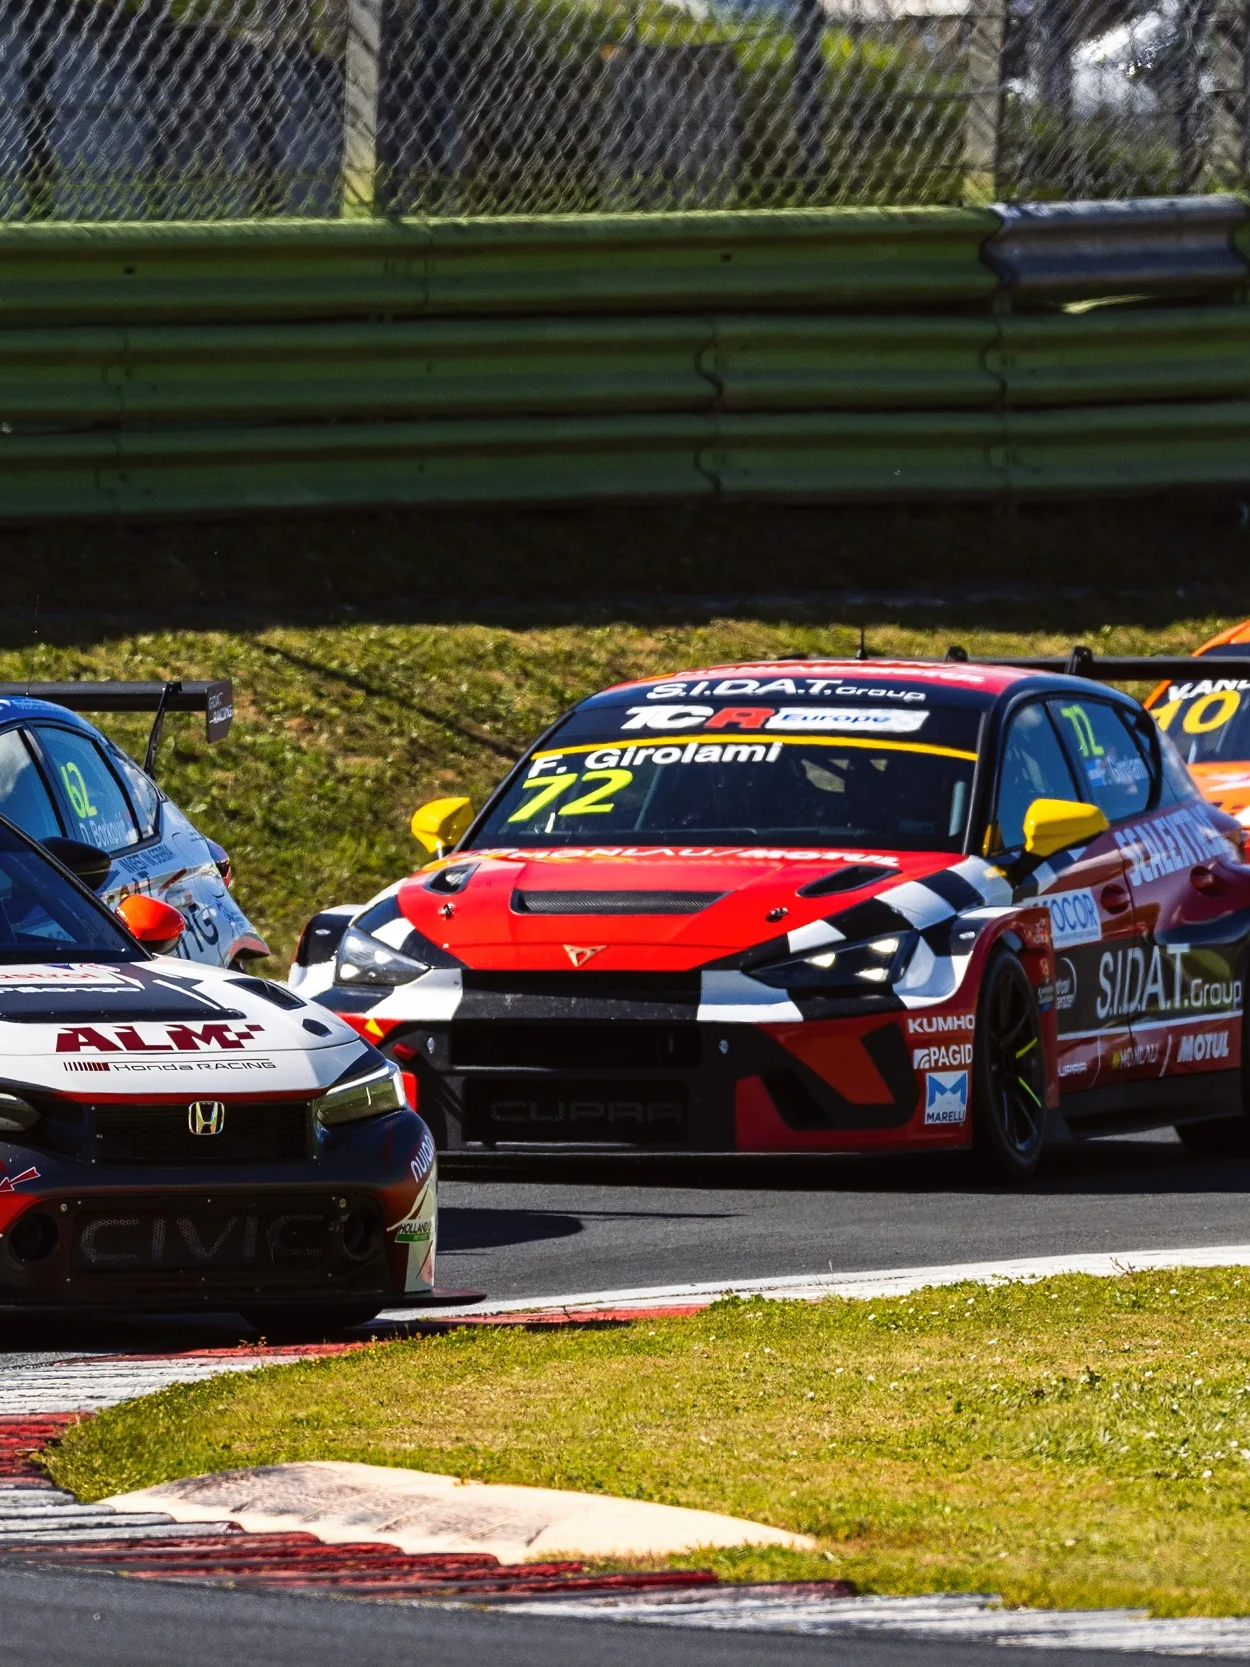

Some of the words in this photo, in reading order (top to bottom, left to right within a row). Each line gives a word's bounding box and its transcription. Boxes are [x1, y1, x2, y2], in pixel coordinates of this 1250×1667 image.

[620, 705, 776, 730] TCR
[781, 711, 891, 726] Europe
[1151, 690, 1242, 734] 10
[1060, 704, 1104, 758] 72
[528, 752, 568, 779] F.
[585, 742, 784, 770] Girolami
[60, 761, 98, 818] 62
[508, 769, 634, 823] 72
[1033, 893, 1099, 932] OCOR
[56, 1023, 265, 1052] ALM
[908, 1014, 975, 1034] KUMHO
[930, 1043, 974, 1067] PAGID
[1177, 1030, 1230, 1063] MOTUL
[113, 1063, 194, 1072] Honda
[196, 1061, 277, 1071] RACING
[490, 1101, 683, 1123] CUPRA
[926, 1110, 966, 1123] MARELLI
[81, 1212, 324, 1263] CIVIC
